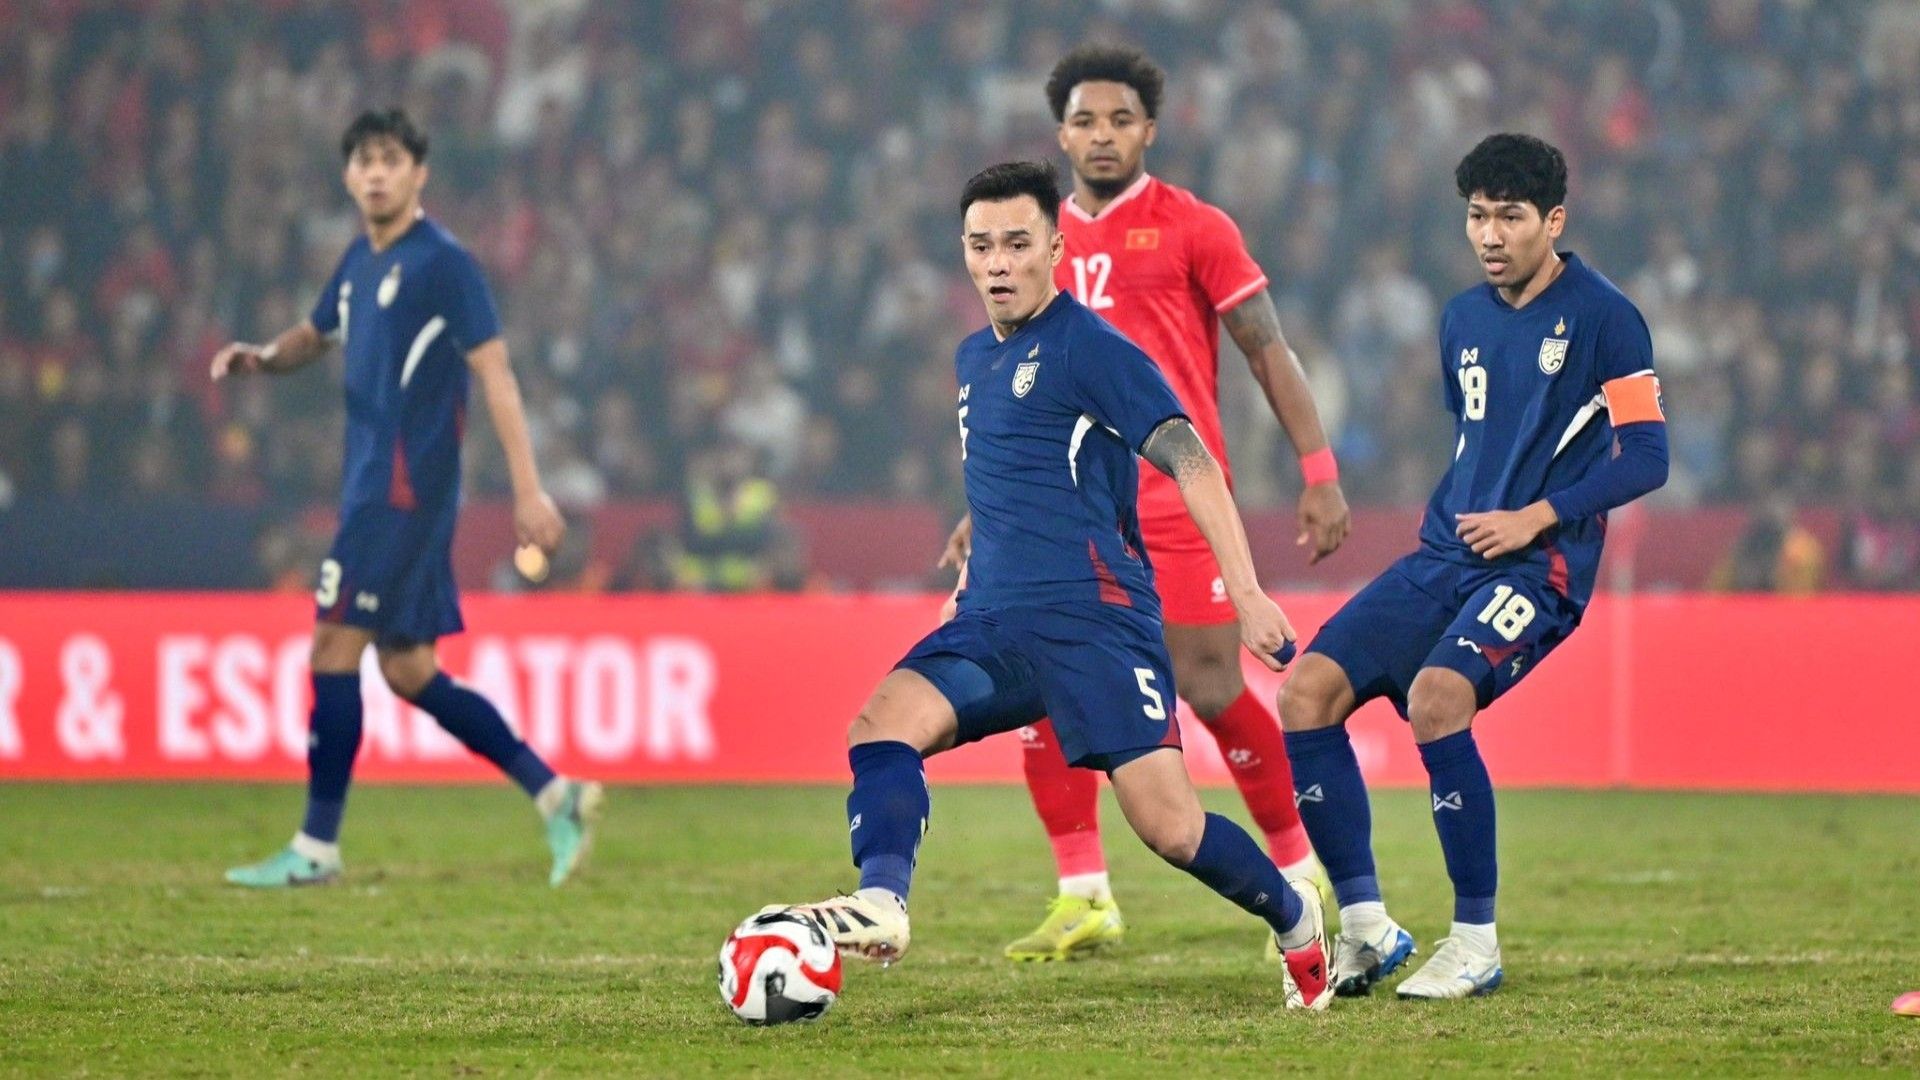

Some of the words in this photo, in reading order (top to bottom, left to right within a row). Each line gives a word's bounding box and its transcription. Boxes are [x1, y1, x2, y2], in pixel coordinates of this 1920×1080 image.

[1071, 252, 1115, 309] 12
[316, 559, 342, 608] 3
[1477, 584, 1536, 642] 18
[56, 634, 124, 760] &
[1133, 667, 1167, 721] 5
